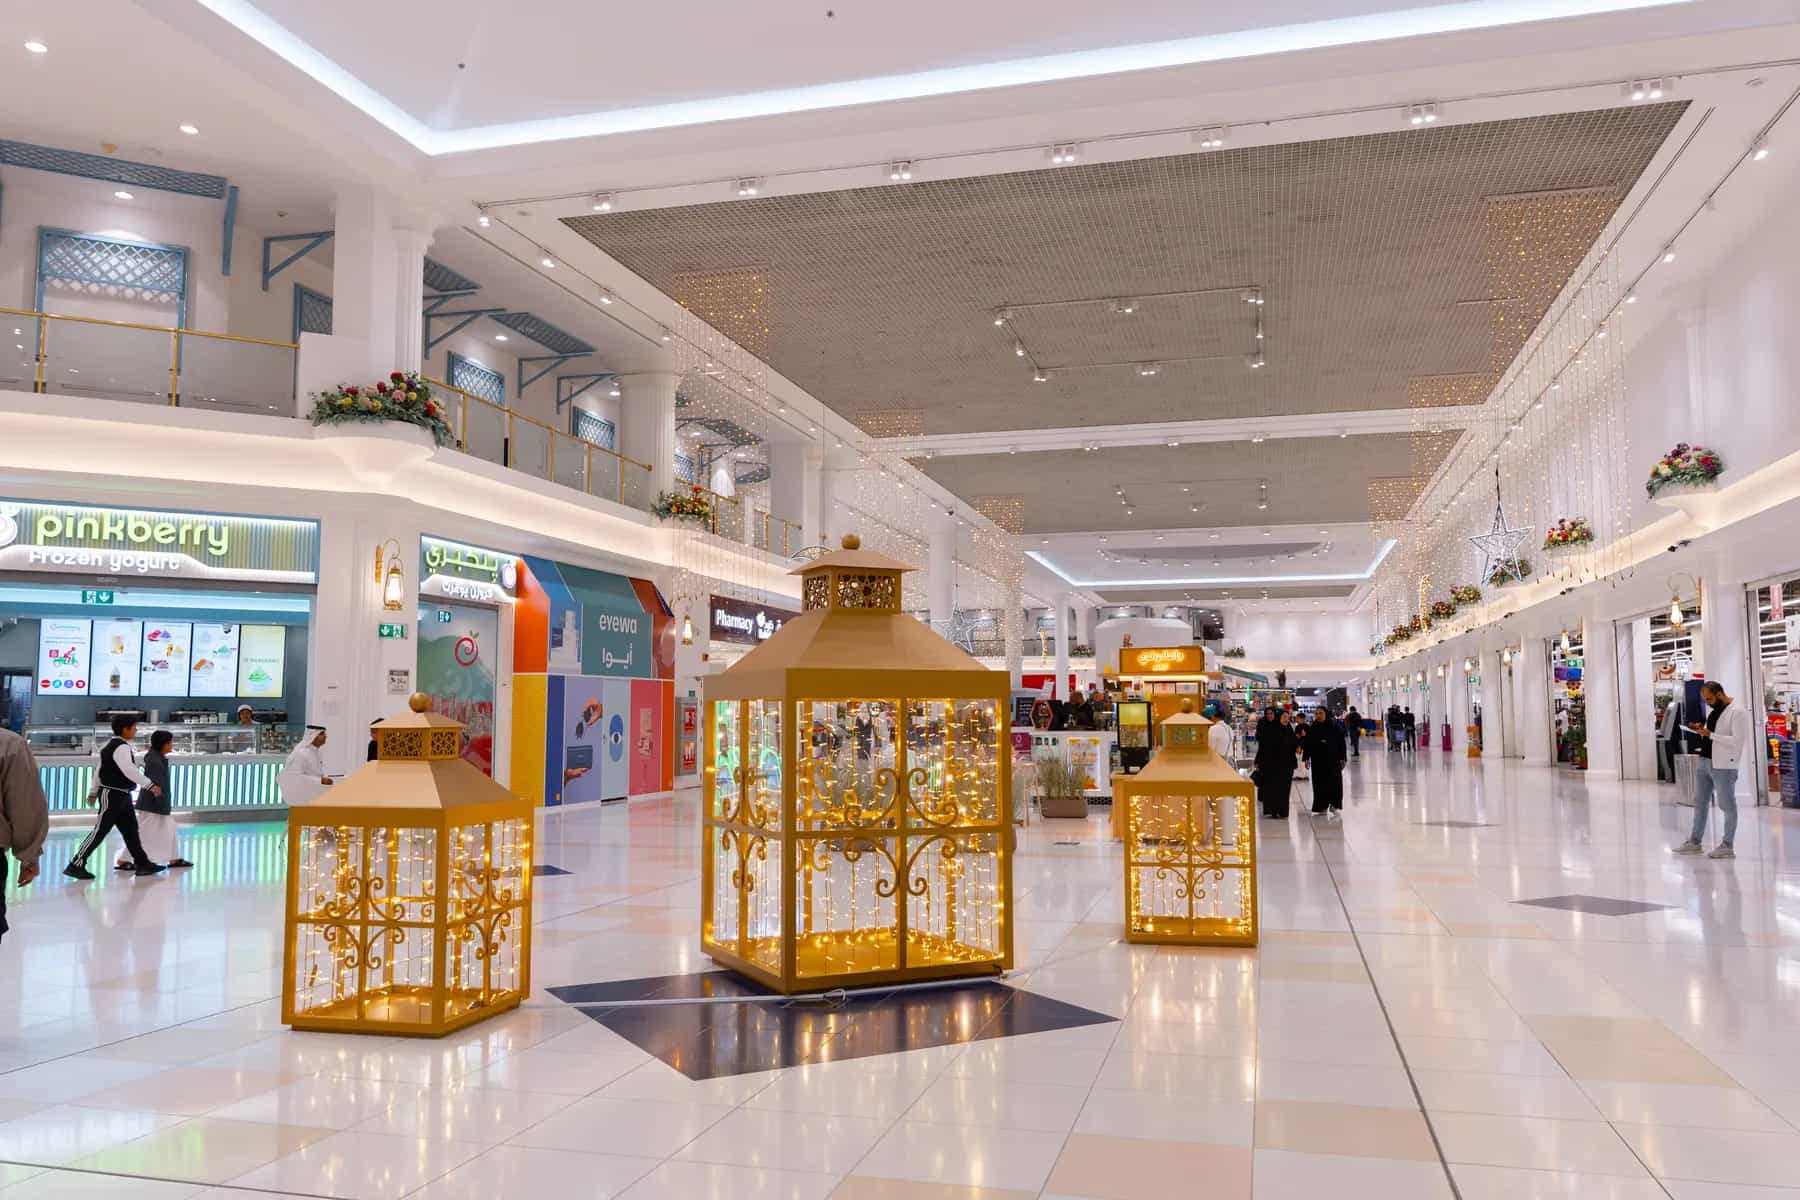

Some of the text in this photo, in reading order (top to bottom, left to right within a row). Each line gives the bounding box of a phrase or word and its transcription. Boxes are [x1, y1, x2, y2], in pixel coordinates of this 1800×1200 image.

[37, 511, 229, 556] pinkberry
[29, 551, 180, 572] Frozen yogurt
[600, 614, 637, 633] eyewa
[716, 609, 753, 634] Pharmacy
